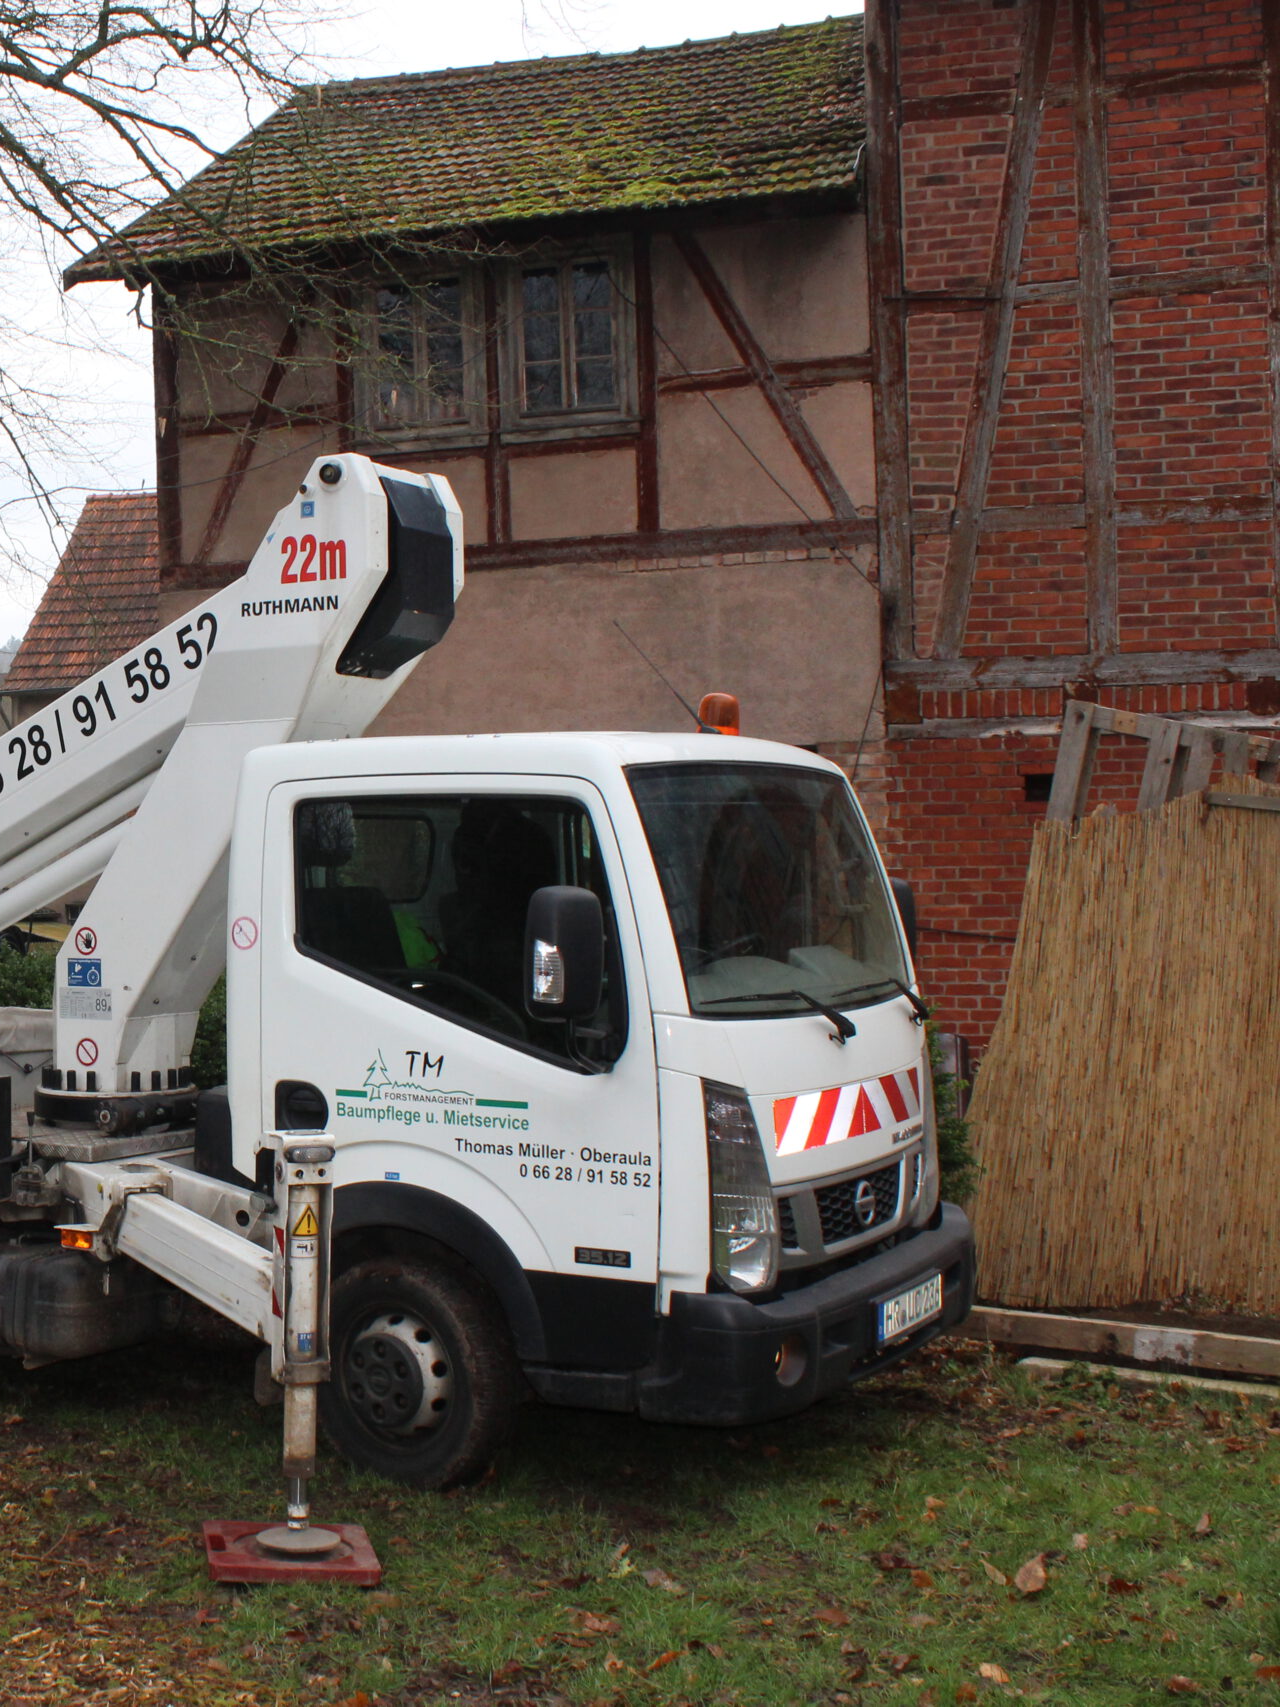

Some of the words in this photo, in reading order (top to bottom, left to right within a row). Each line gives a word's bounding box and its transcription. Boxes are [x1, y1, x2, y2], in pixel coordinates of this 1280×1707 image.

[280, 533, 347, 585] 22m
[240, 595, 339, 617] RUTHMANN
[8, 724, 52, 782] 28
[72, 680, 117, 737] 91
[123, 647, 170, 704] 58
[95, 998, 107, 1011] 89
[405, 1050, 444, 1078] TM
[384, 1091, 474, 1106] FORSTMANAGEMENT
[336, 1101, 421, 1126] Baumpflege
[425, 1110, 439, 1125] u.
[444, 1109, 530, 1131] Mietservice
[454, 1137, 514, 1157] Thomas
[518, 1142, 566, 1160] Müller
[579, 1146, 652, 1167] Oberaula
[519, 1163, 528, 1178] 0
[533, 1164, 550, 1180] 66
[555, 1166, 573, 1182] 28
[587, 1168, 604, 1184] 91
[610, 1170, 628, 1186] 58
[633, 1172, 652, 1188] 52
